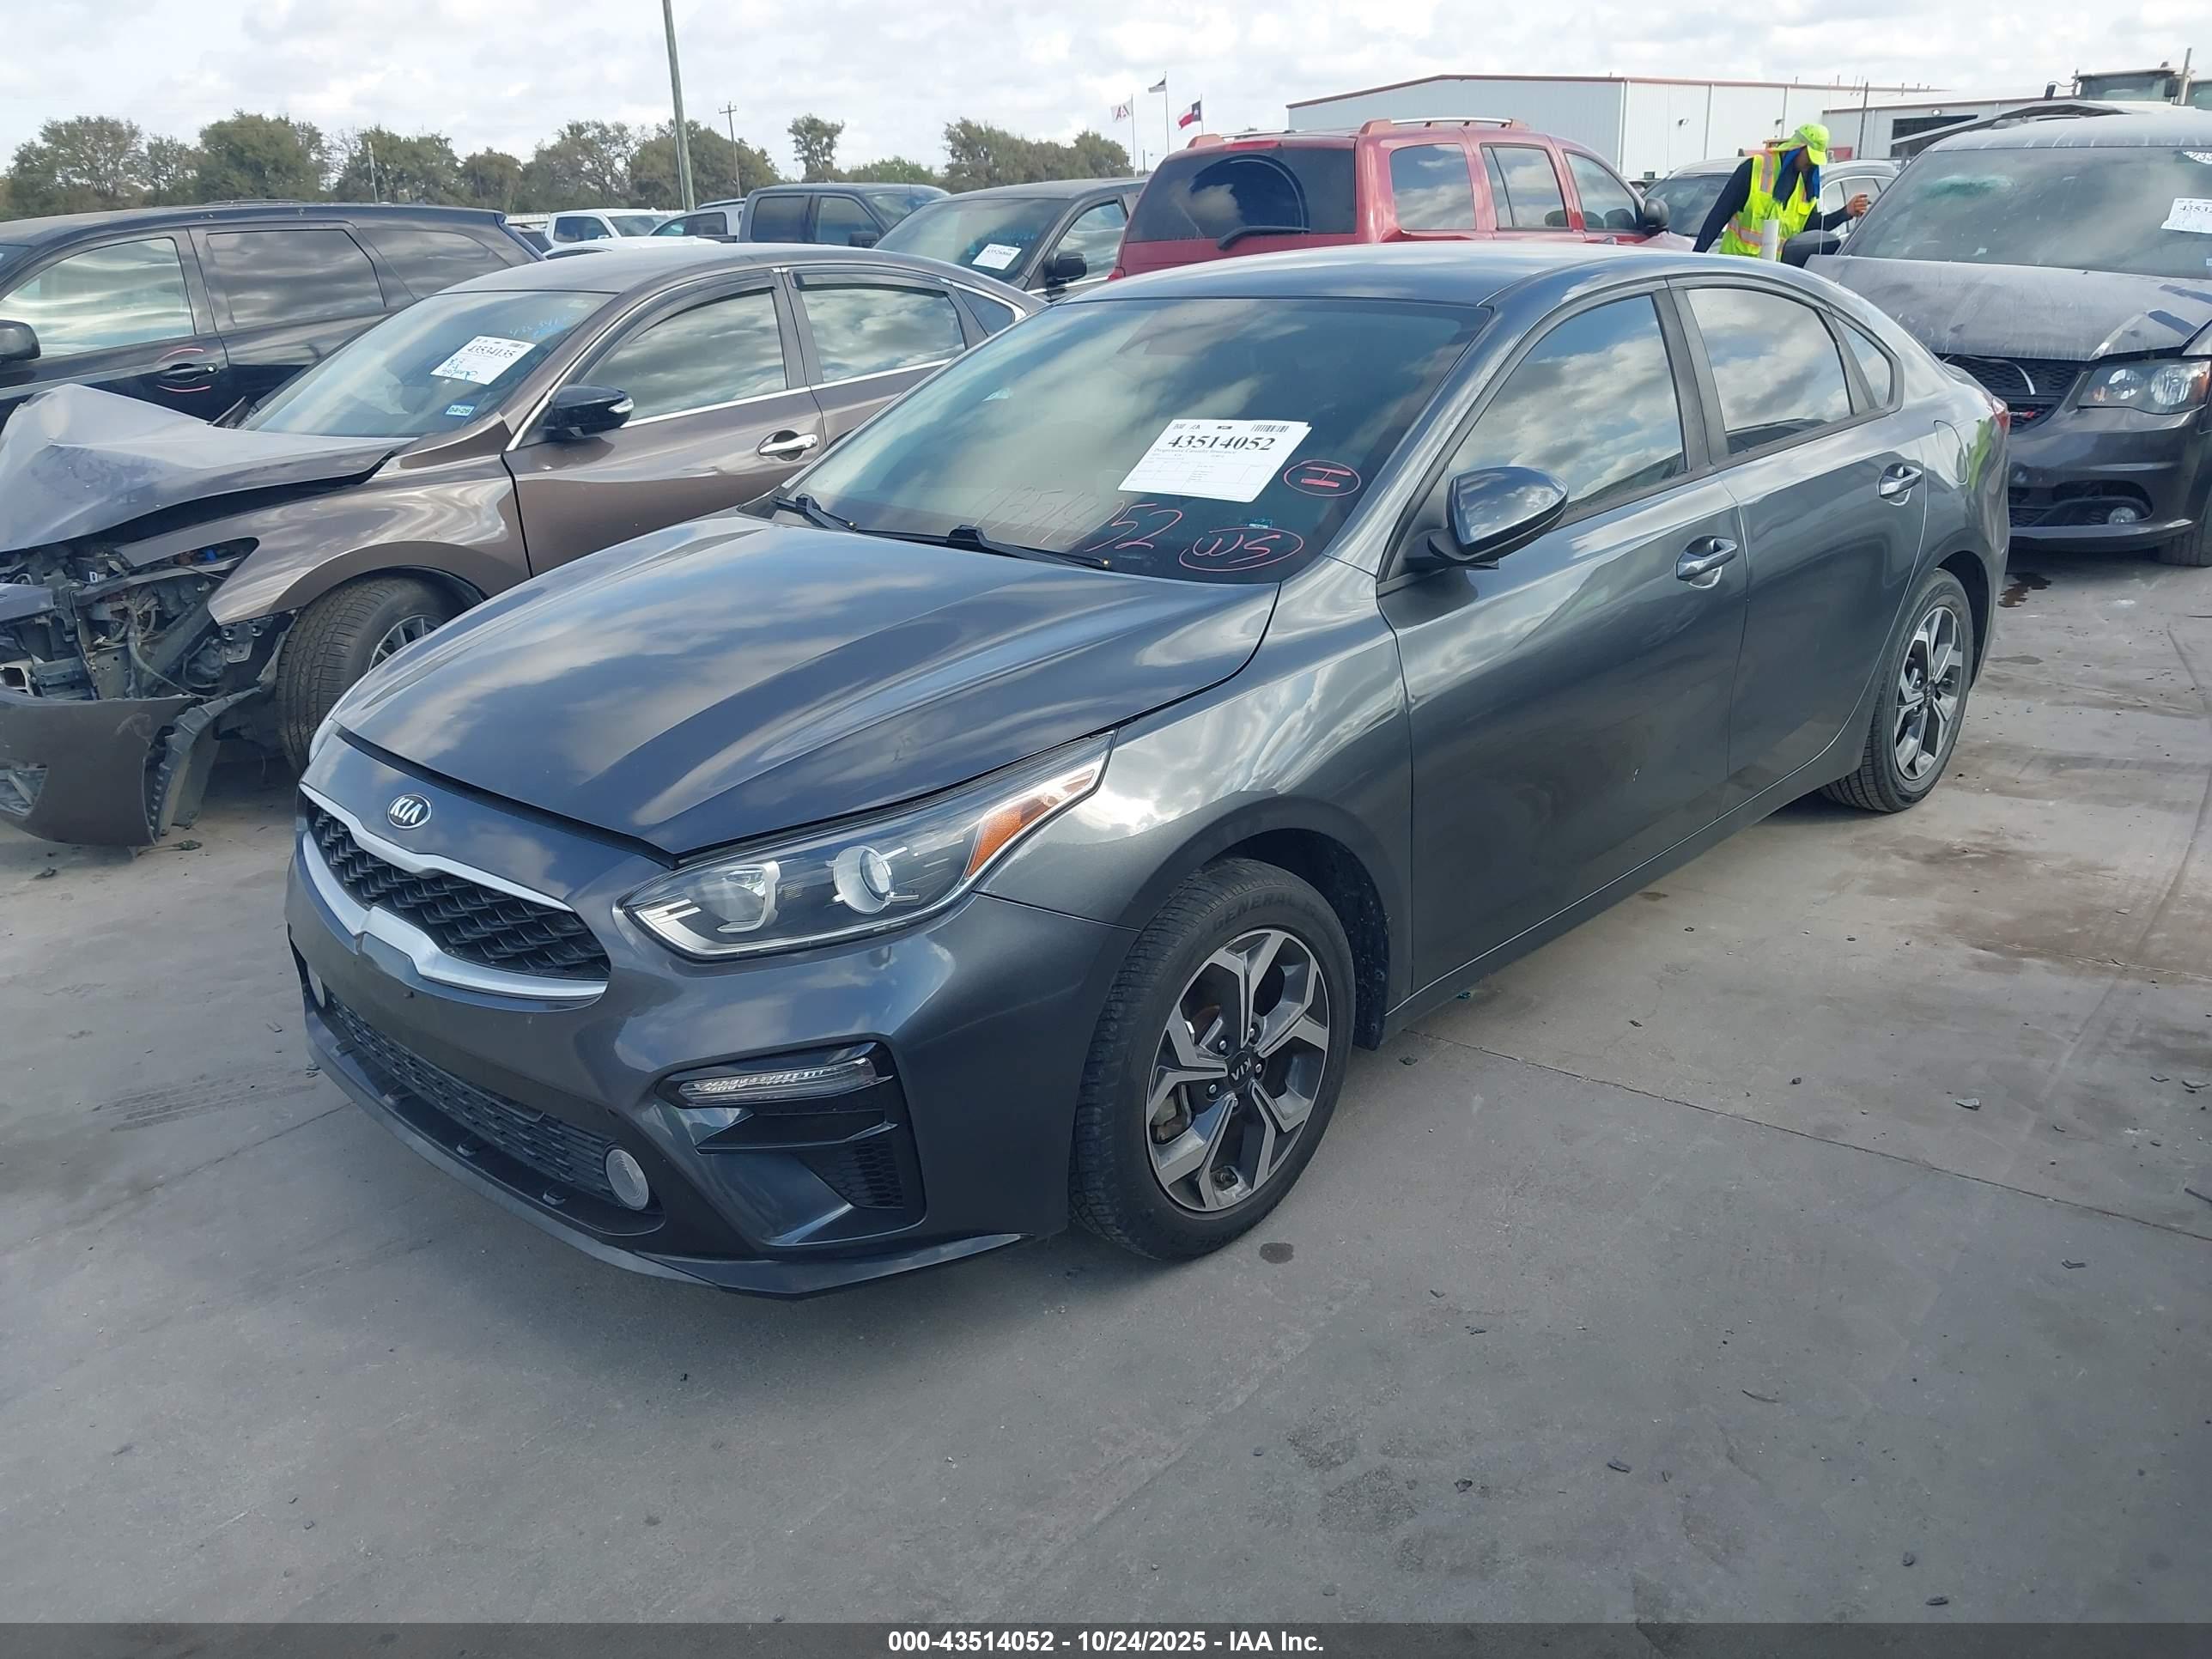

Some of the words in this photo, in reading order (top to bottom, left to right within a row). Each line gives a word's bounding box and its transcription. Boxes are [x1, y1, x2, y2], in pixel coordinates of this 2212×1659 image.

[1168, 435, 1275, 451] 43514052
[1192, 534, 1281, 565] WS
[390, 797, 423, 824] KIA
[1213, 892, 1297, 933] GENERAL
[1231, 1057, 1252, 1081] KIA
